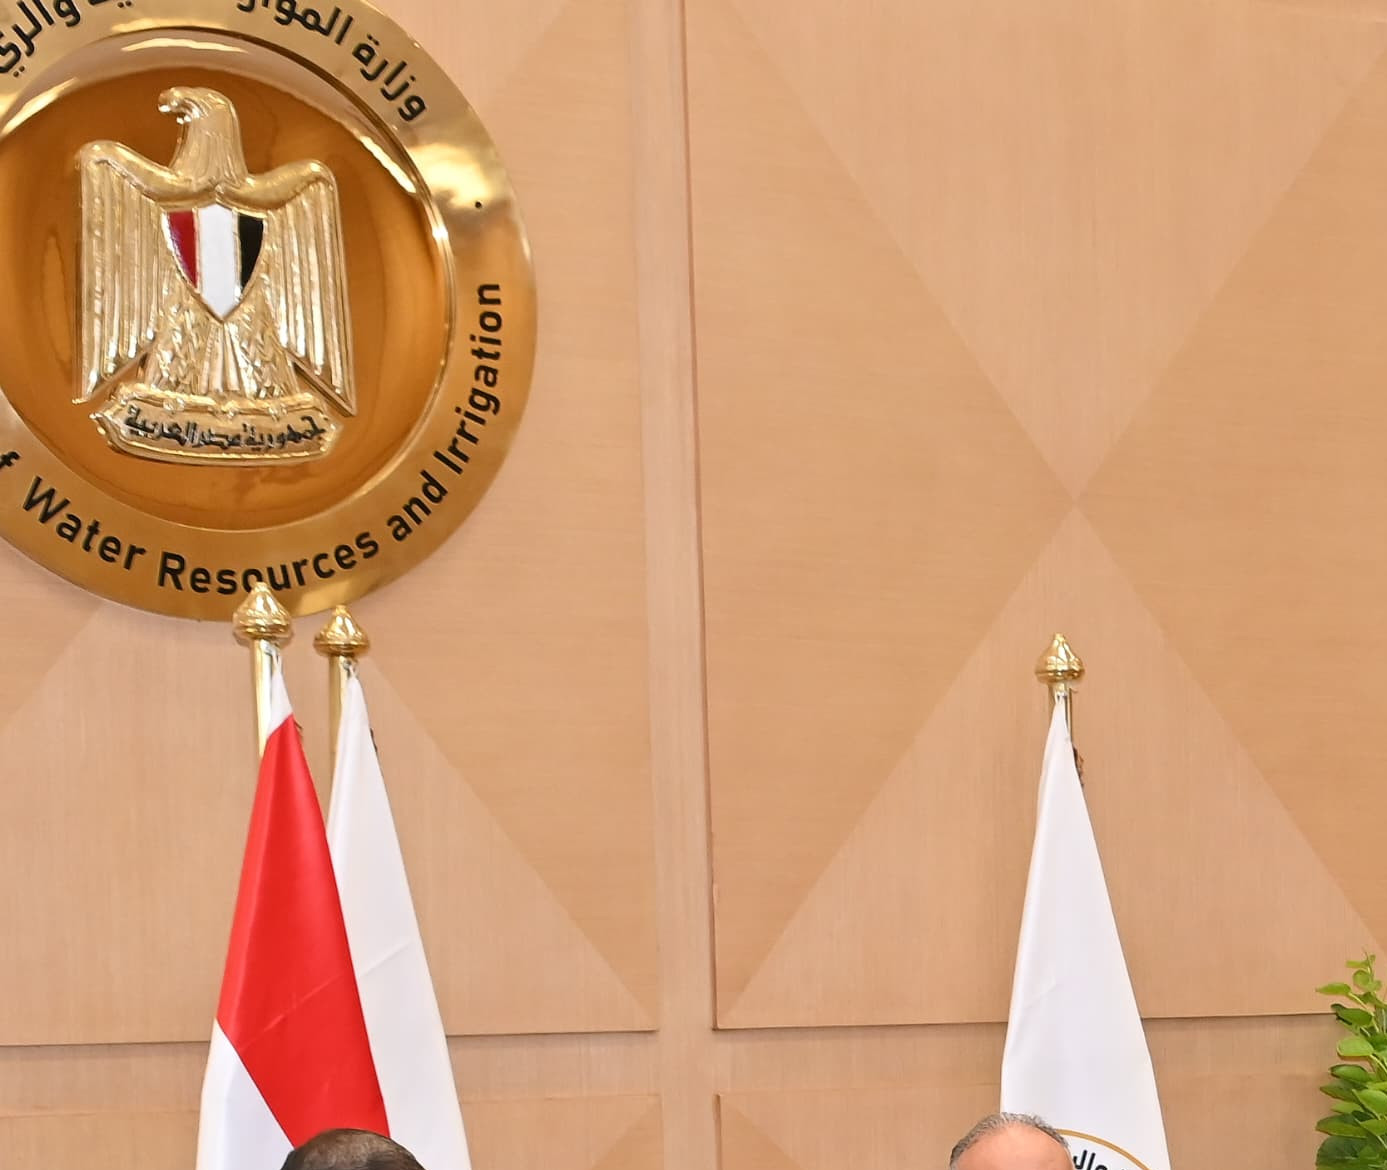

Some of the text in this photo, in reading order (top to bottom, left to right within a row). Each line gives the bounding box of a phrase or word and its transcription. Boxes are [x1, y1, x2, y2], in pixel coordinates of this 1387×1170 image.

[352, 33, 426, 122] وزارة
[23, 475, 147, 571] Water
[158, 531, 380, 596] Resources
[386, 469, 449, 542] and
[432, 283, 503, 476] Irrigation
